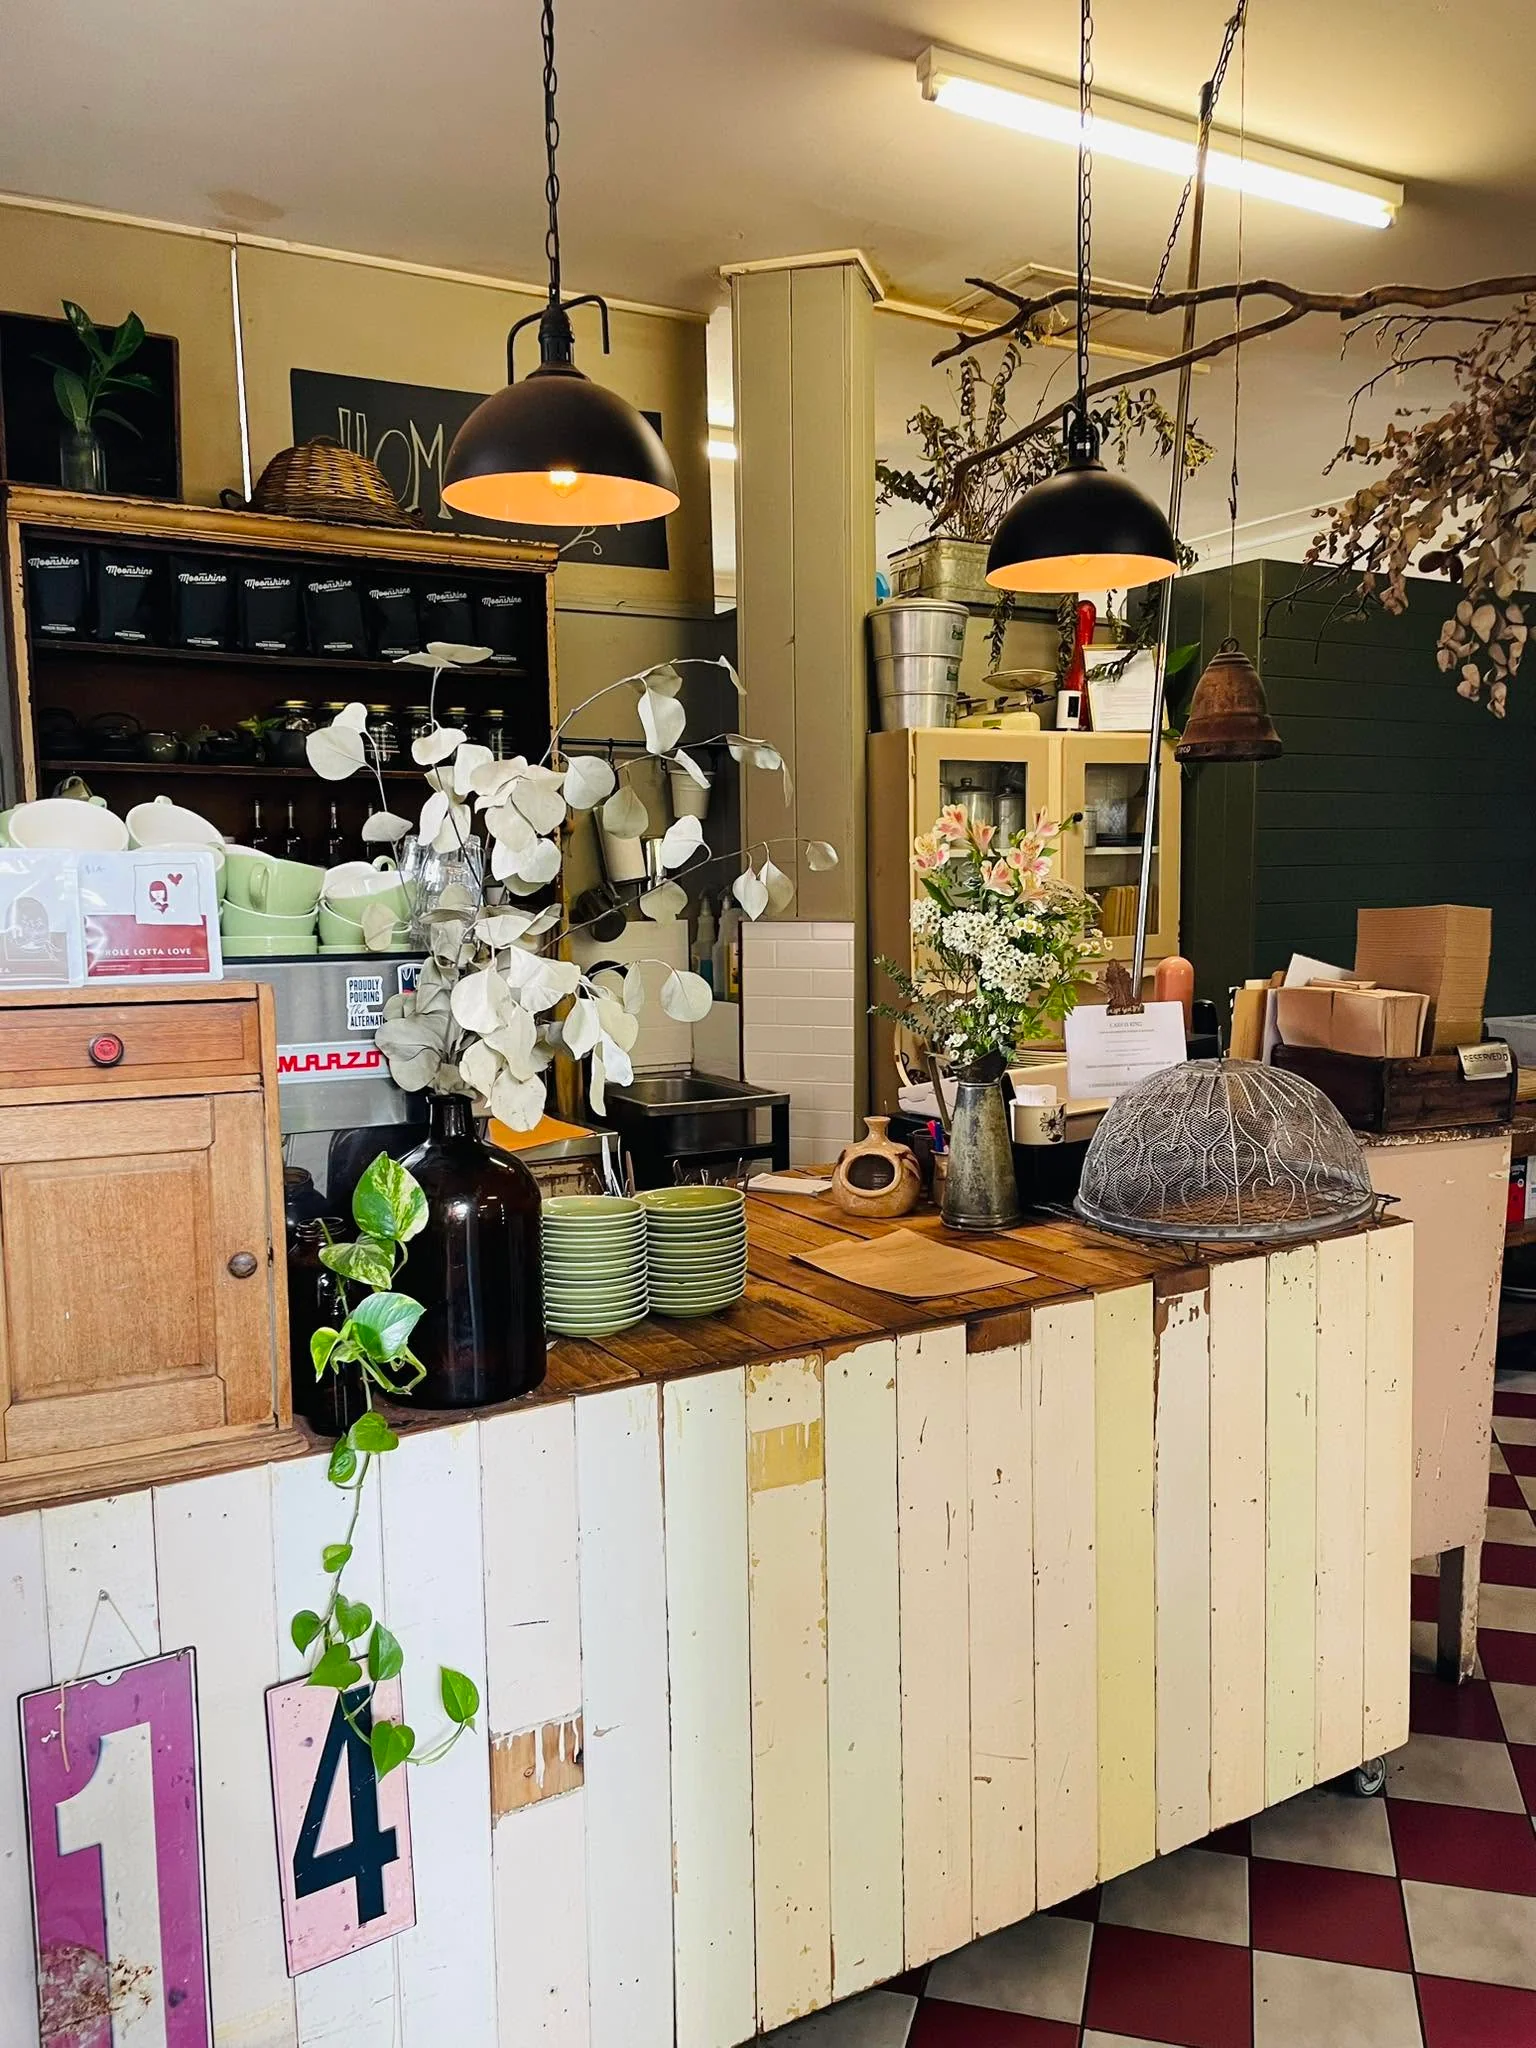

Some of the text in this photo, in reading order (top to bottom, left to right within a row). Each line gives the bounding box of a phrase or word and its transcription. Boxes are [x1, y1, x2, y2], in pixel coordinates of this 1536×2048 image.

[28, 557, 79, 568] Moonshine
[106, 565, 152, 576] Moonshine
[178, 573, 227, 584] Moonshine
[245, 578, 290, 589] Moonshine
[308, 580, 352, 593] Moonshine
[369, 588, 410, 599] Moonshine
[427, 591, 467, 603] Moonshine
[482, 596, 522, 607] Moonshine
[104, 946, 192, 956] HOLE LOTTA LOVE
[349, 978, 379, 990] PROUDLY
[349, 991, 380, 1003] POURING
[350, 1004, 365, 1015] The
[1463, 1052, 1501, 1062] RESERVED
[293, 1685, 400, 1926] 4
[56, 1721, 167, 2048] 1
